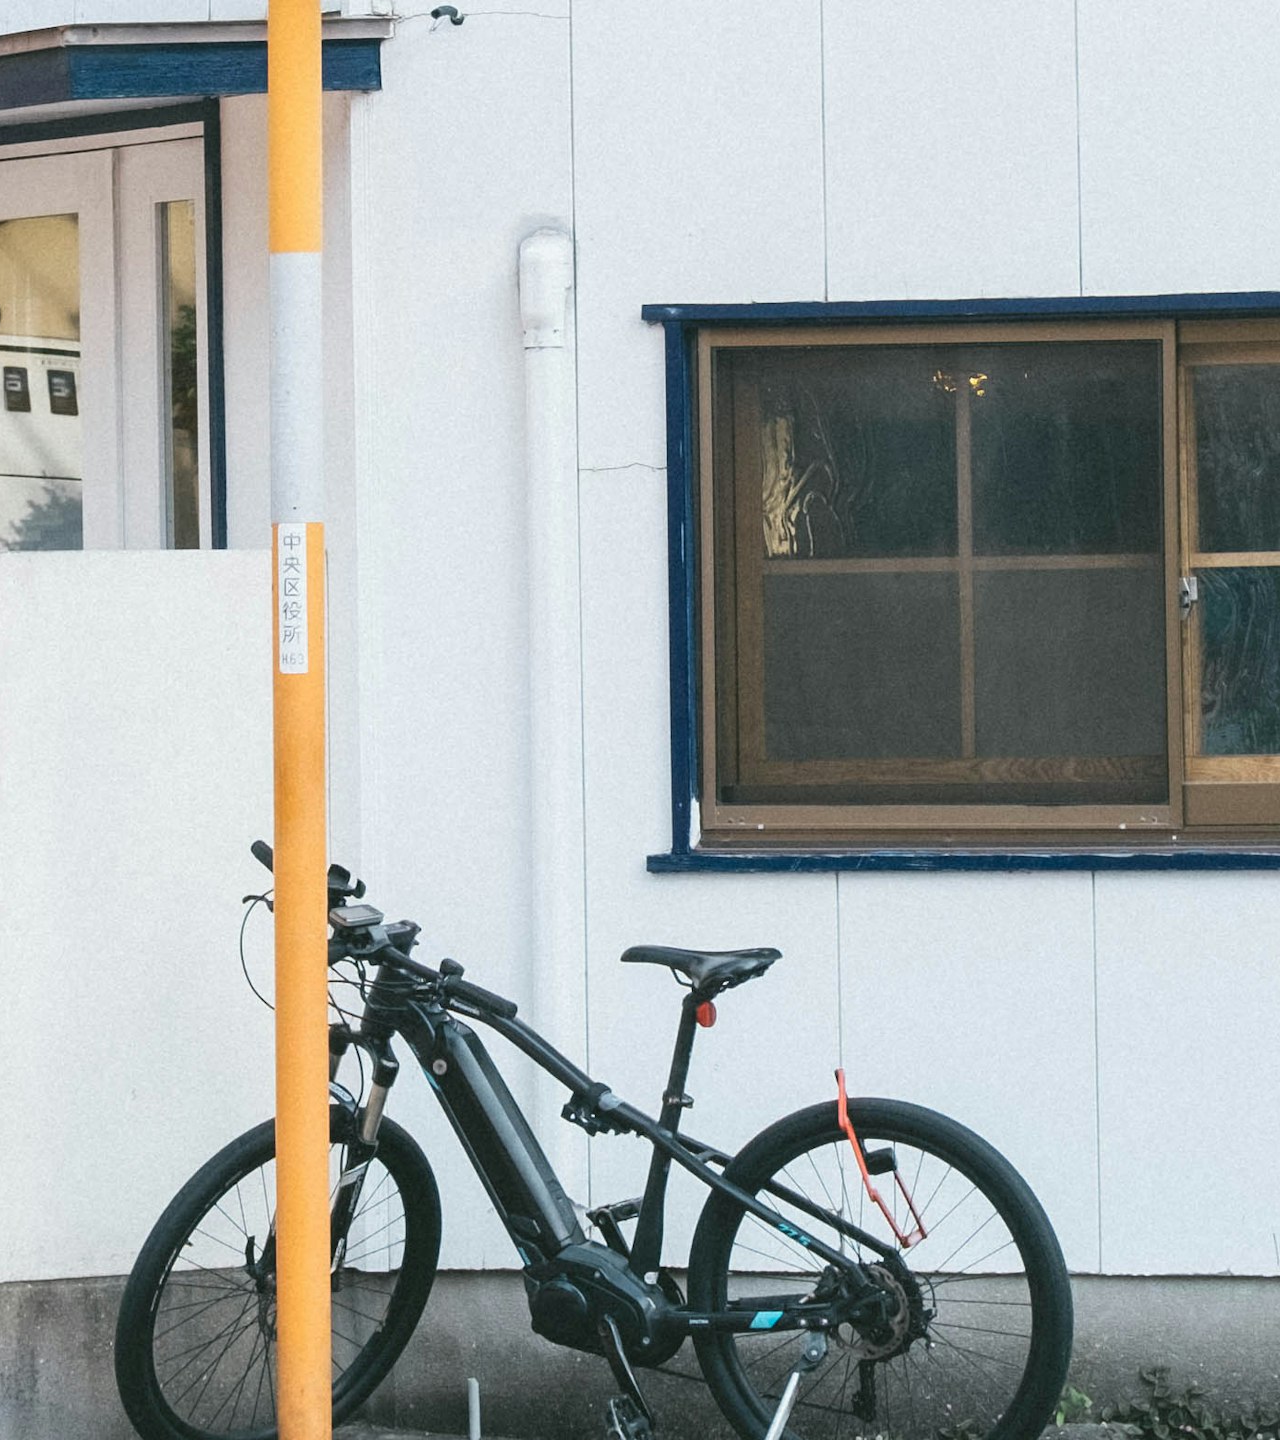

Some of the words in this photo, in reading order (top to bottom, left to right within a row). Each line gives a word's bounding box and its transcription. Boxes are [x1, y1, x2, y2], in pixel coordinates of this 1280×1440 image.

[282, 533, 302, 644] 中央区役所
